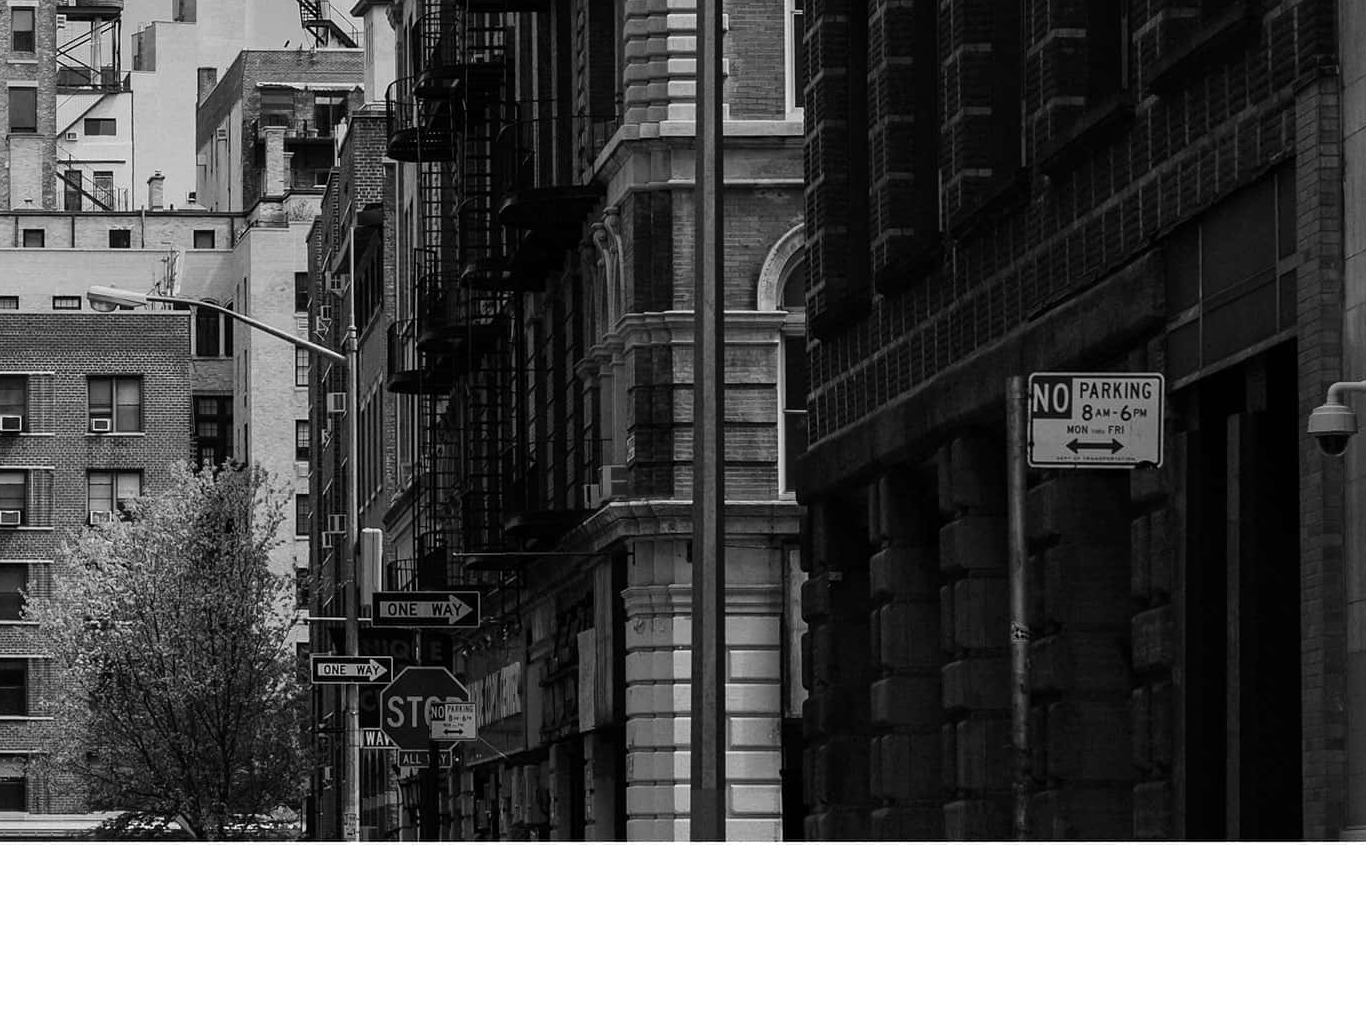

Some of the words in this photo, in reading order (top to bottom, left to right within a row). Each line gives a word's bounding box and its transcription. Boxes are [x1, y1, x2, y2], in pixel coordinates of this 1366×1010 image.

[1033, 383, 1069, 413] NO
[1080, 381, 1152, 399] PARKING
[1066, 425, 1088, 434] MON
[1108, 425, 1125, 434] FRI
[388, 603, 417, 616] ONE
[431, 603, 463, 616] WAY
[323, 665, 346, 675] ONE
[356, 665, 380, 675] WAY
[432, 705, 444, 718] NO
[402, 753, 422, 764] ALL
